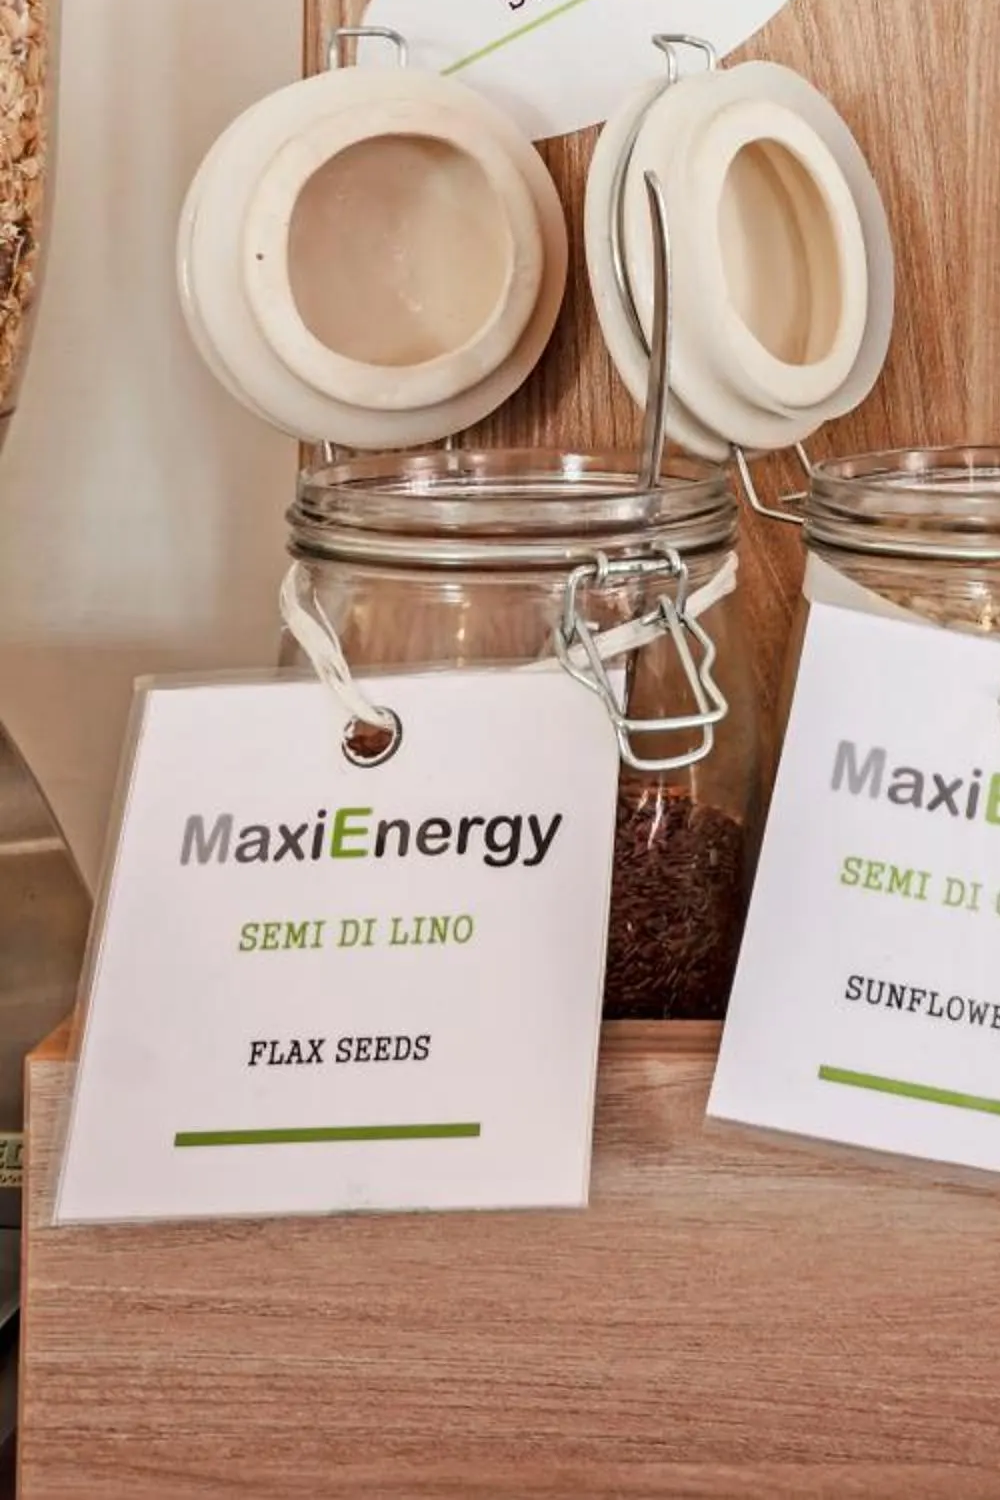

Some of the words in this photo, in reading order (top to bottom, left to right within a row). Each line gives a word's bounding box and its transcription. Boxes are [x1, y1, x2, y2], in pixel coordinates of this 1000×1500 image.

[180, 807, 563, 868] MaxiEnergy
[840, 856, 932, 901] SEMI
[942, 876, 985, 912] DI
[238, 920, 324, 952] SEMI
[337, 918, 376, 947] DI
[390, 915, 475, 946] LINO
[248, 1040, 325, 1067] FLAX
[335, 1035, 432, 1063] SEEDS
